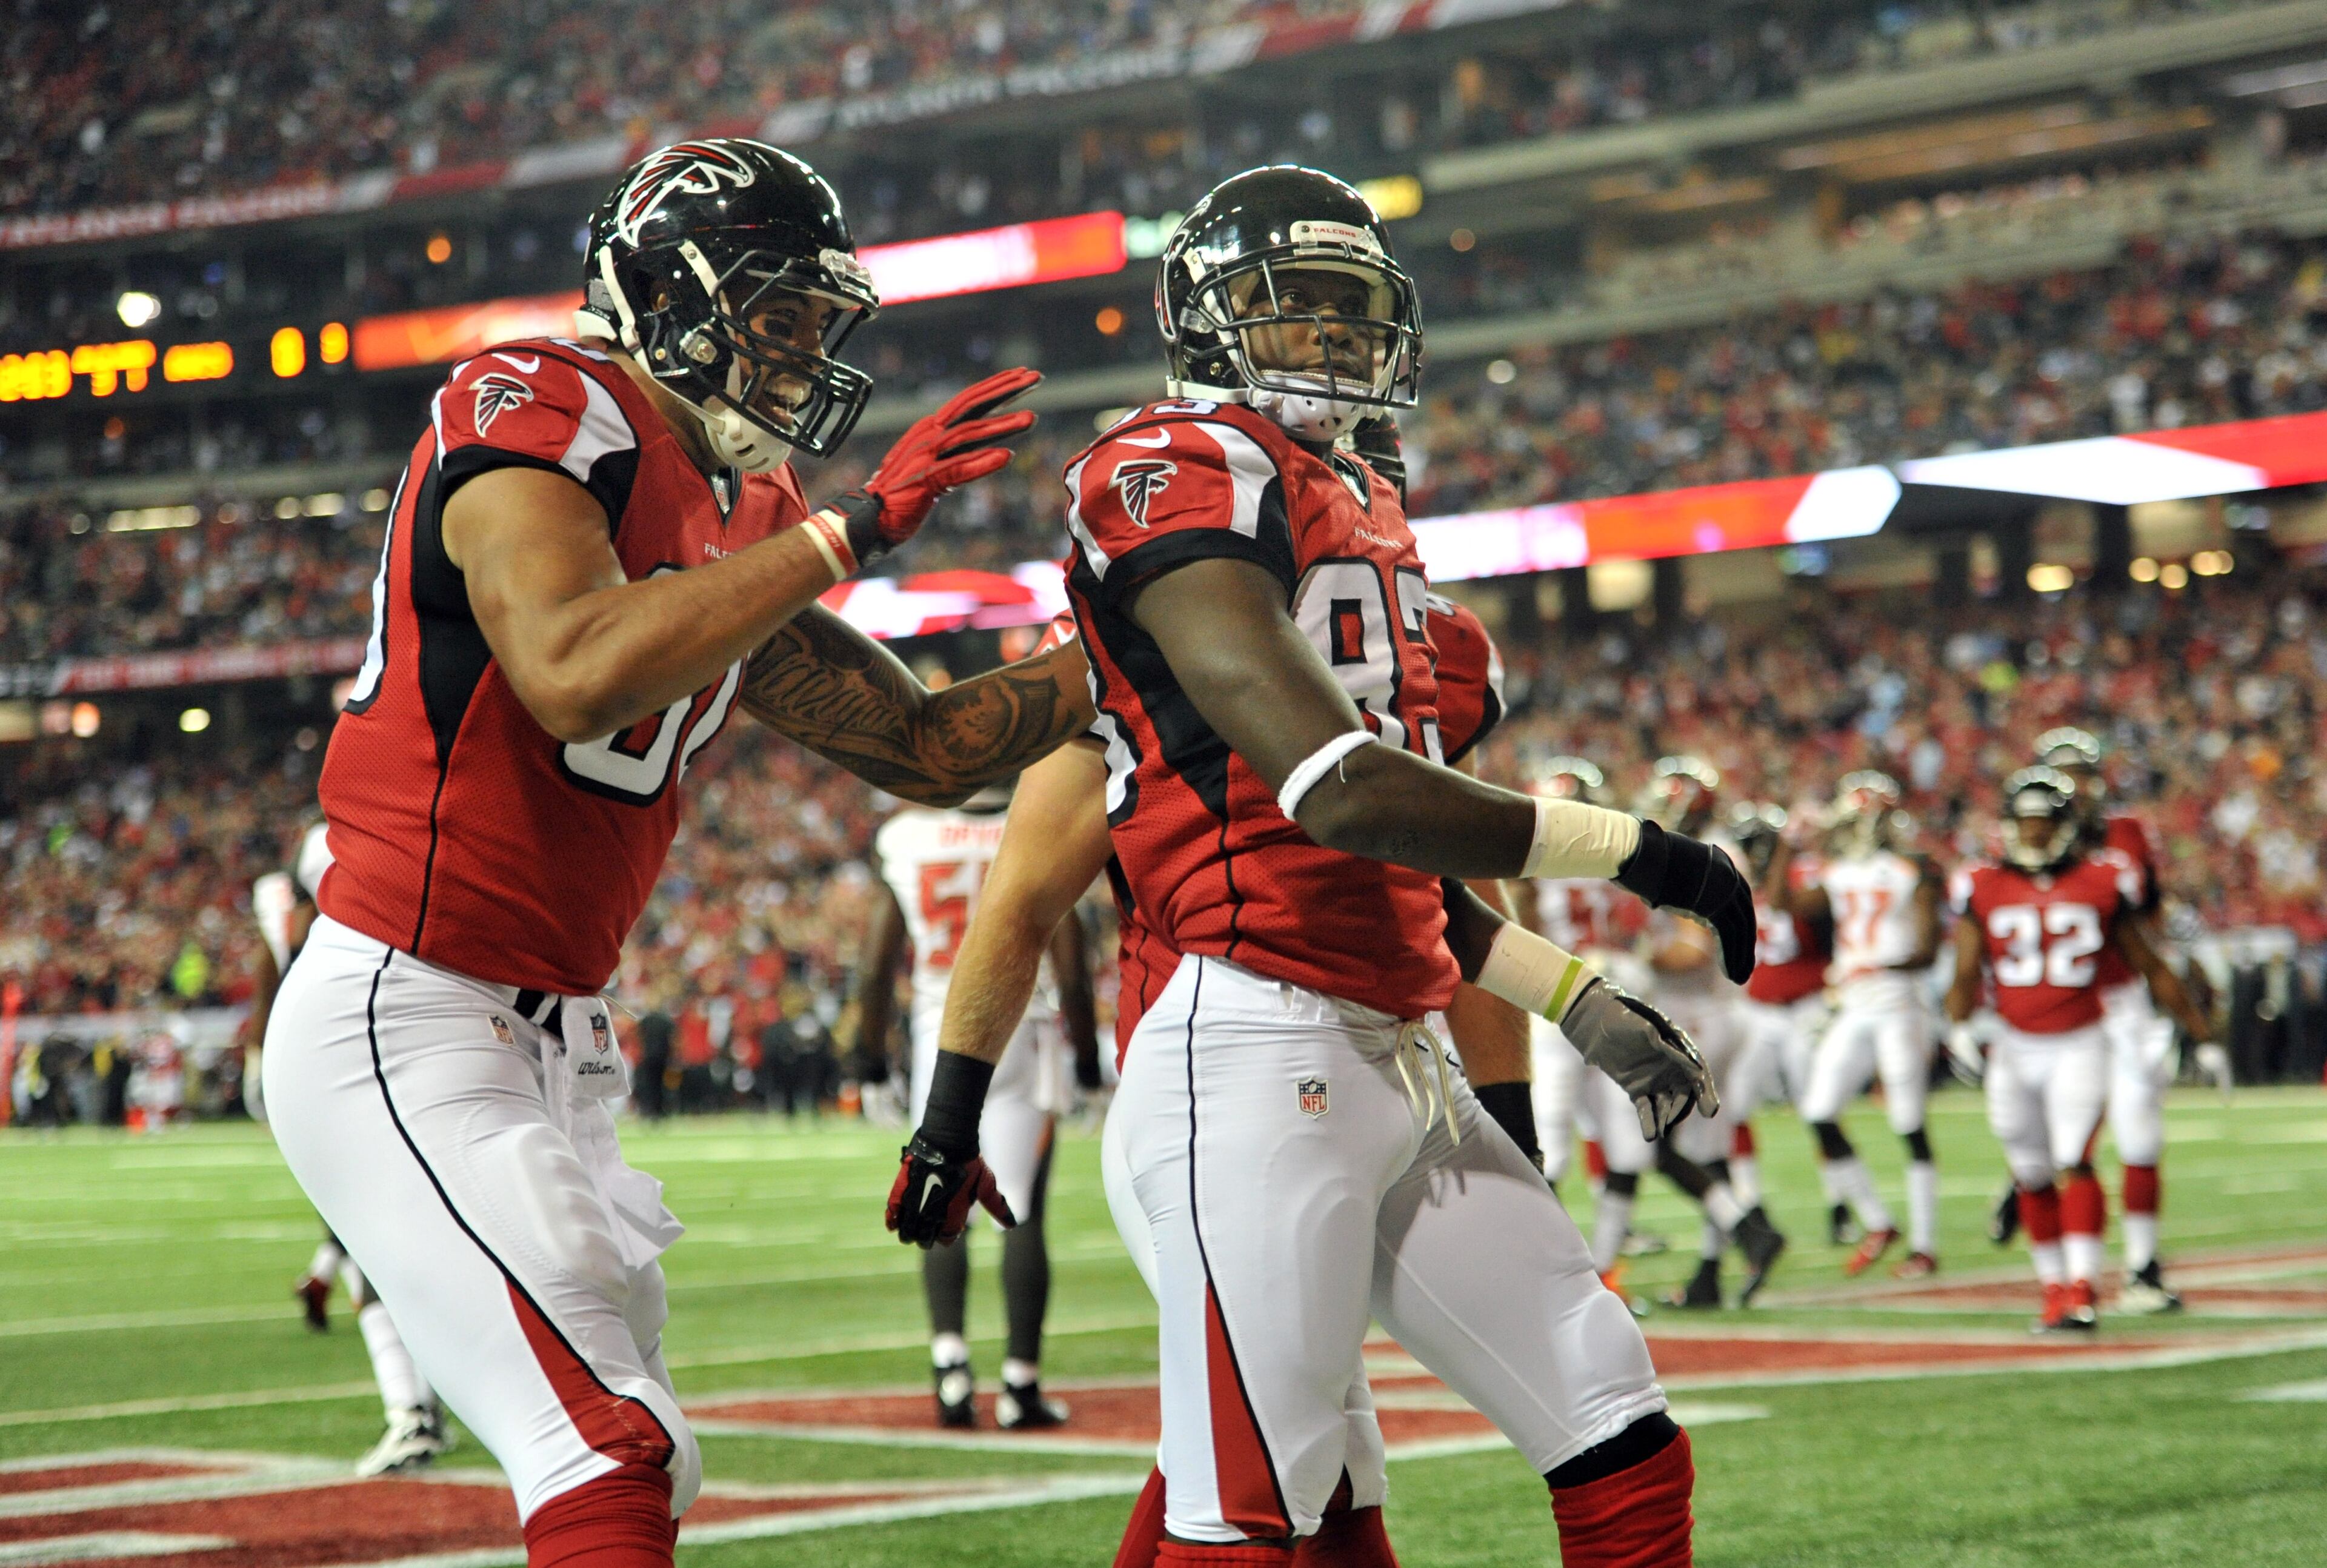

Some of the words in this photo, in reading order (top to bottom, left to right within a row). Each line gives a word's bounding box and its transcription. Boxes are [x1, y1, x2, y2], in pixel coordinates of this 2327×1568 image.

[1313, 228, 1356, 238] FALCONS
[1354, 526, 1404, 548] FALCONS
[704, 542, 732, 559] FALC
[1988, 902, 2105, 988] 32
[1302, 1095, 1325, 1112] NFL
